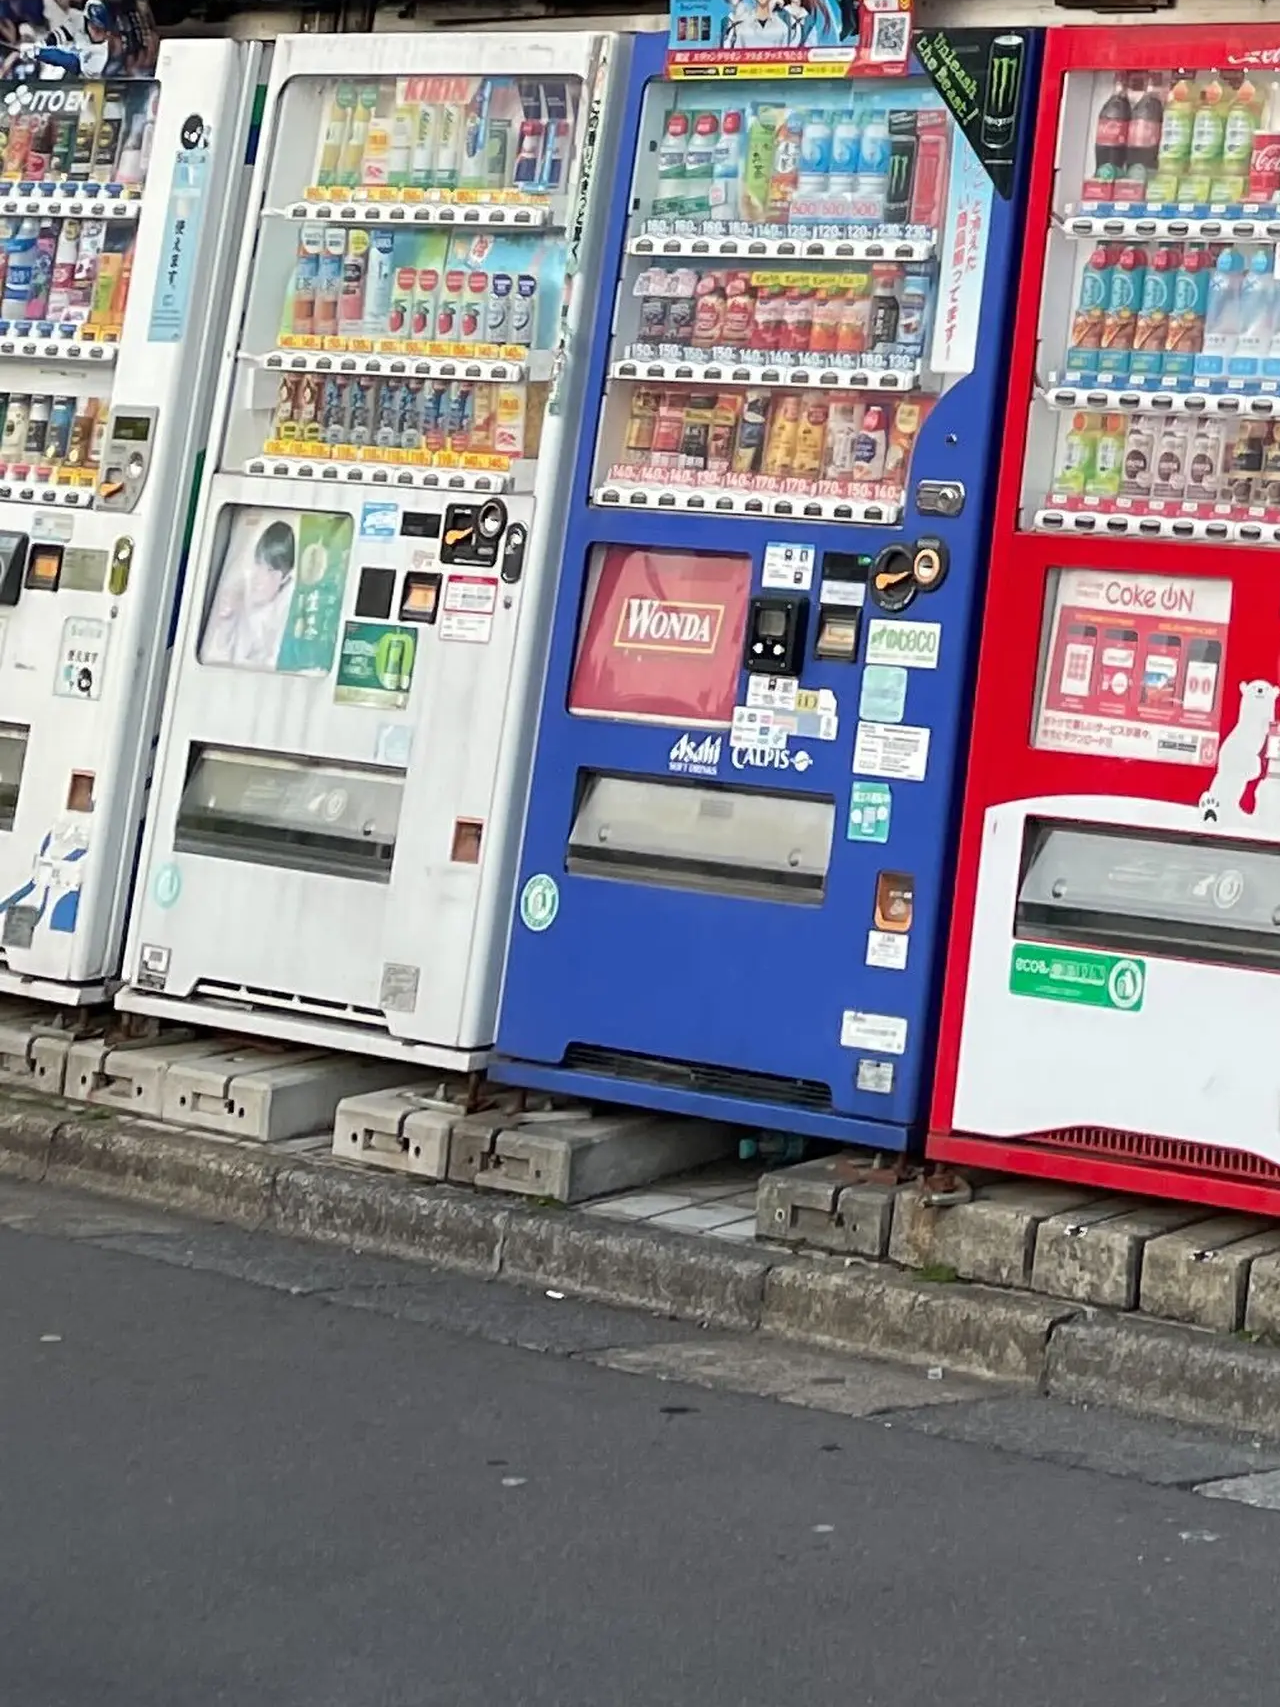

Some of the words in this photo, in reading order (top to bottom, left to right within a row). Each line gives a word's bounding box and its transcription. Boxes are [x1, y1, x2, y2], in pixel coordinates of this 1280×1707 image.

[933, 31, 978, 100] Unleash
[29, 90, 65, 112] ITO
[64, 90, 92, 113] EN
[403, 75, 469, 102] KIRIN
[1105, 581, 1157, 609] Coke
[1160, 582, 1195, 612] ON
[627, 598, 711, 642] WONDA
[669, 733, 722, 764] Asahi
[731, 746, 790, 770] CALPIS
